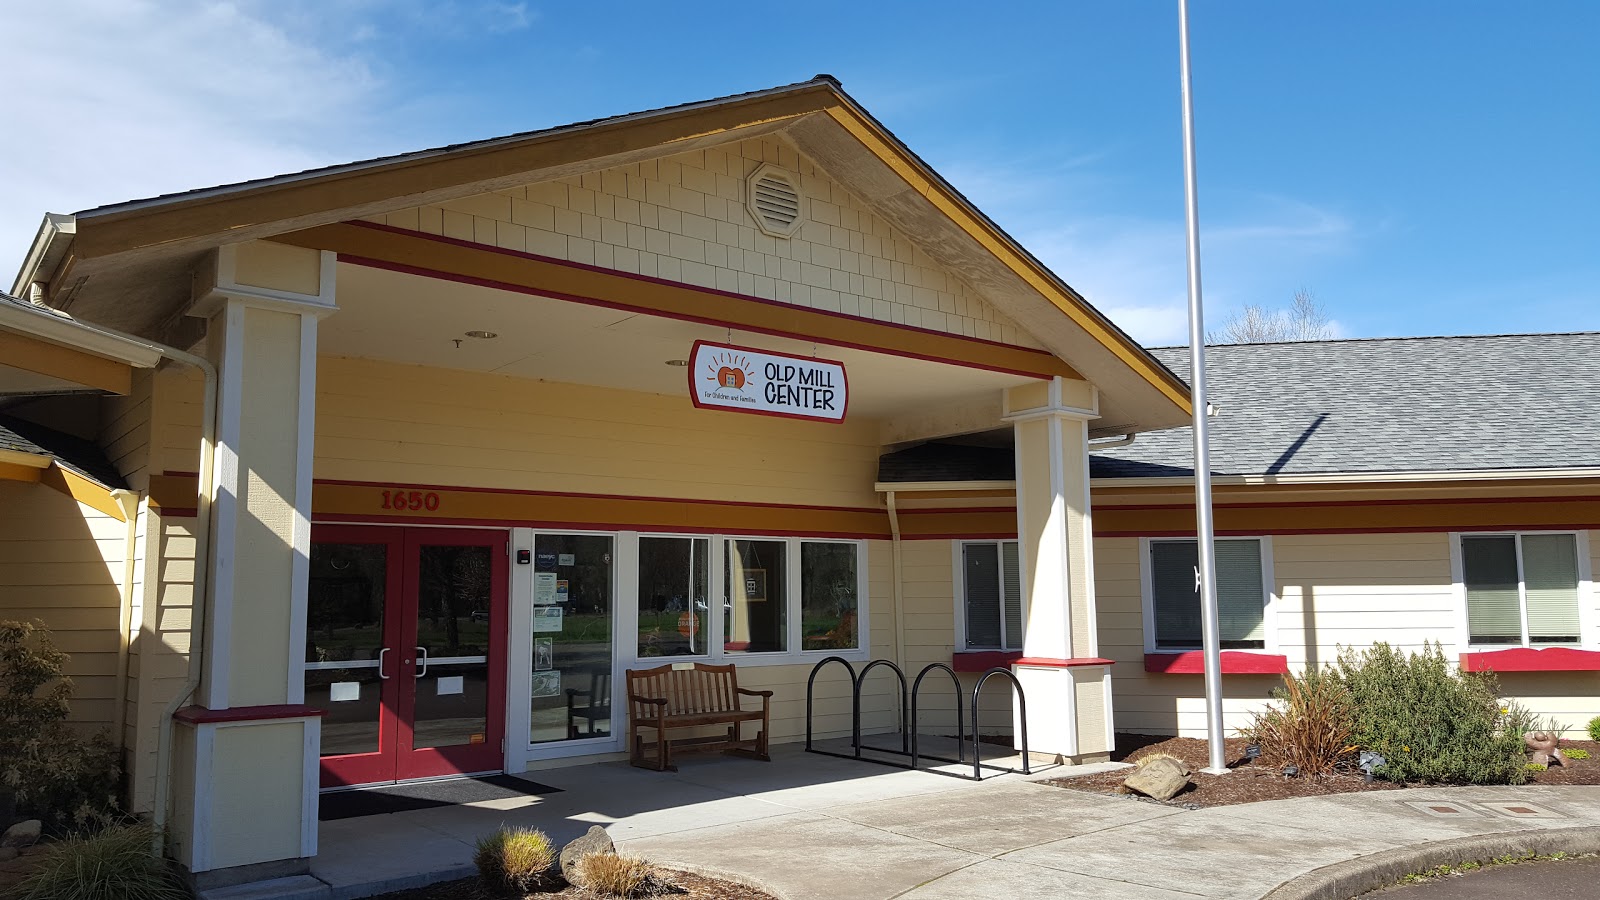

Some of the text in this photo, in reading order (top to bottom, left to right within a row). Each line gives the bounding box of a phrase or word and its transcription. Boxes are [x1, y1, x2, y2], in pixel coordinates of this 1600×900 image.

[764, 362, 835, 388] OLD MILL
[712, 392, 730, 401] Children
[731, 394, 739, 402] and
[740, 395, 756, 403] Families
[764, 382, 835, 411] CENTER
[381, 490, 440, 511] 1650
